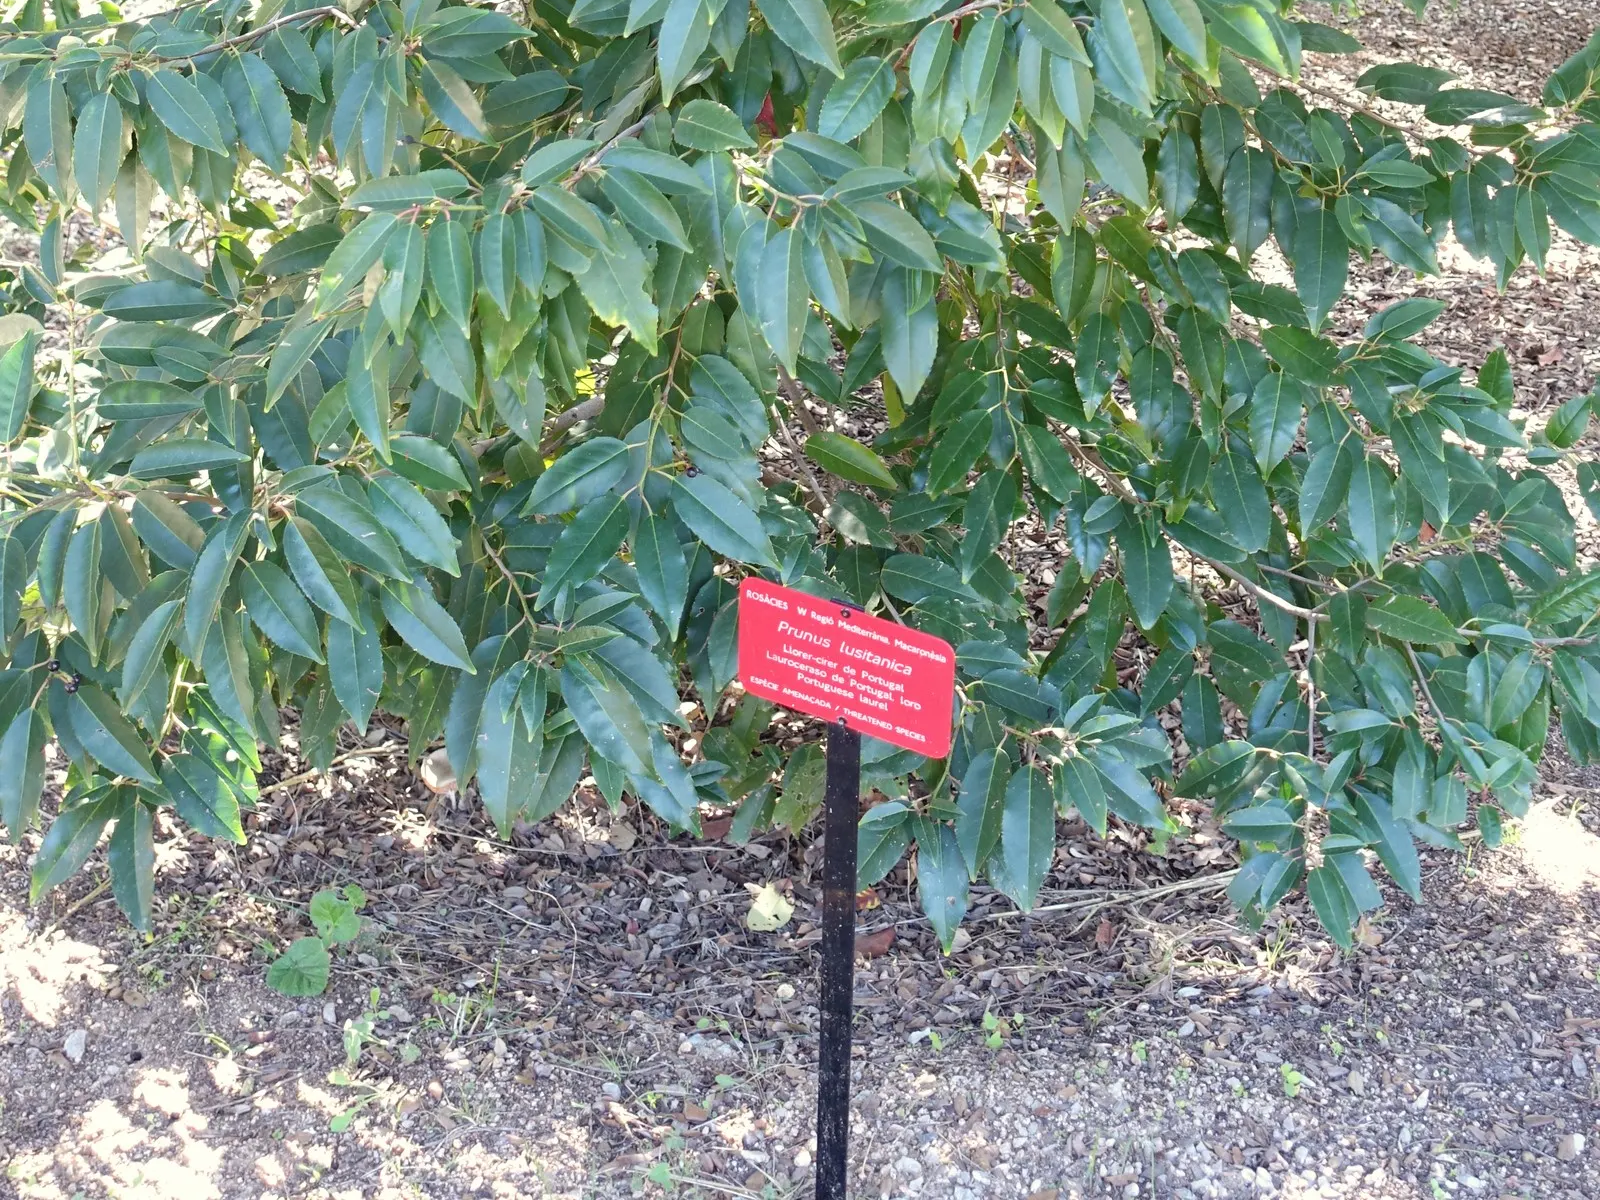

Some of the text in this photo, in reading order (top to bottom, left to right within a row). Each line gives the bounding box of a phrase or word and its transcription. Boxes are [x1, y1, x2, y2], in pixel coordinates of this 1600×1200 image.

[746, 589, 788, 610] ROSÀCIES
[797, 606, 807, 616] W
[810, 611, 834, 625] Regió
[894, 639, 947, 663] Macaronèsia
[777, 620, 913, 675] Prunus lusitanica
[766, 650, 827, 677] Lauroceraso
[831, 674, 845, 684] de
[900, 696, 922, 711] loro
[783, 644, 904, 693] Llorer-cirer de Portugal
[797, 672, 888, 711] Portuguese laurel
[750, 675, 779, 691] ESPÈCIE
[843, 707, 893, 731] THREATENED
[895, 726, 926, 743] SPECIES
